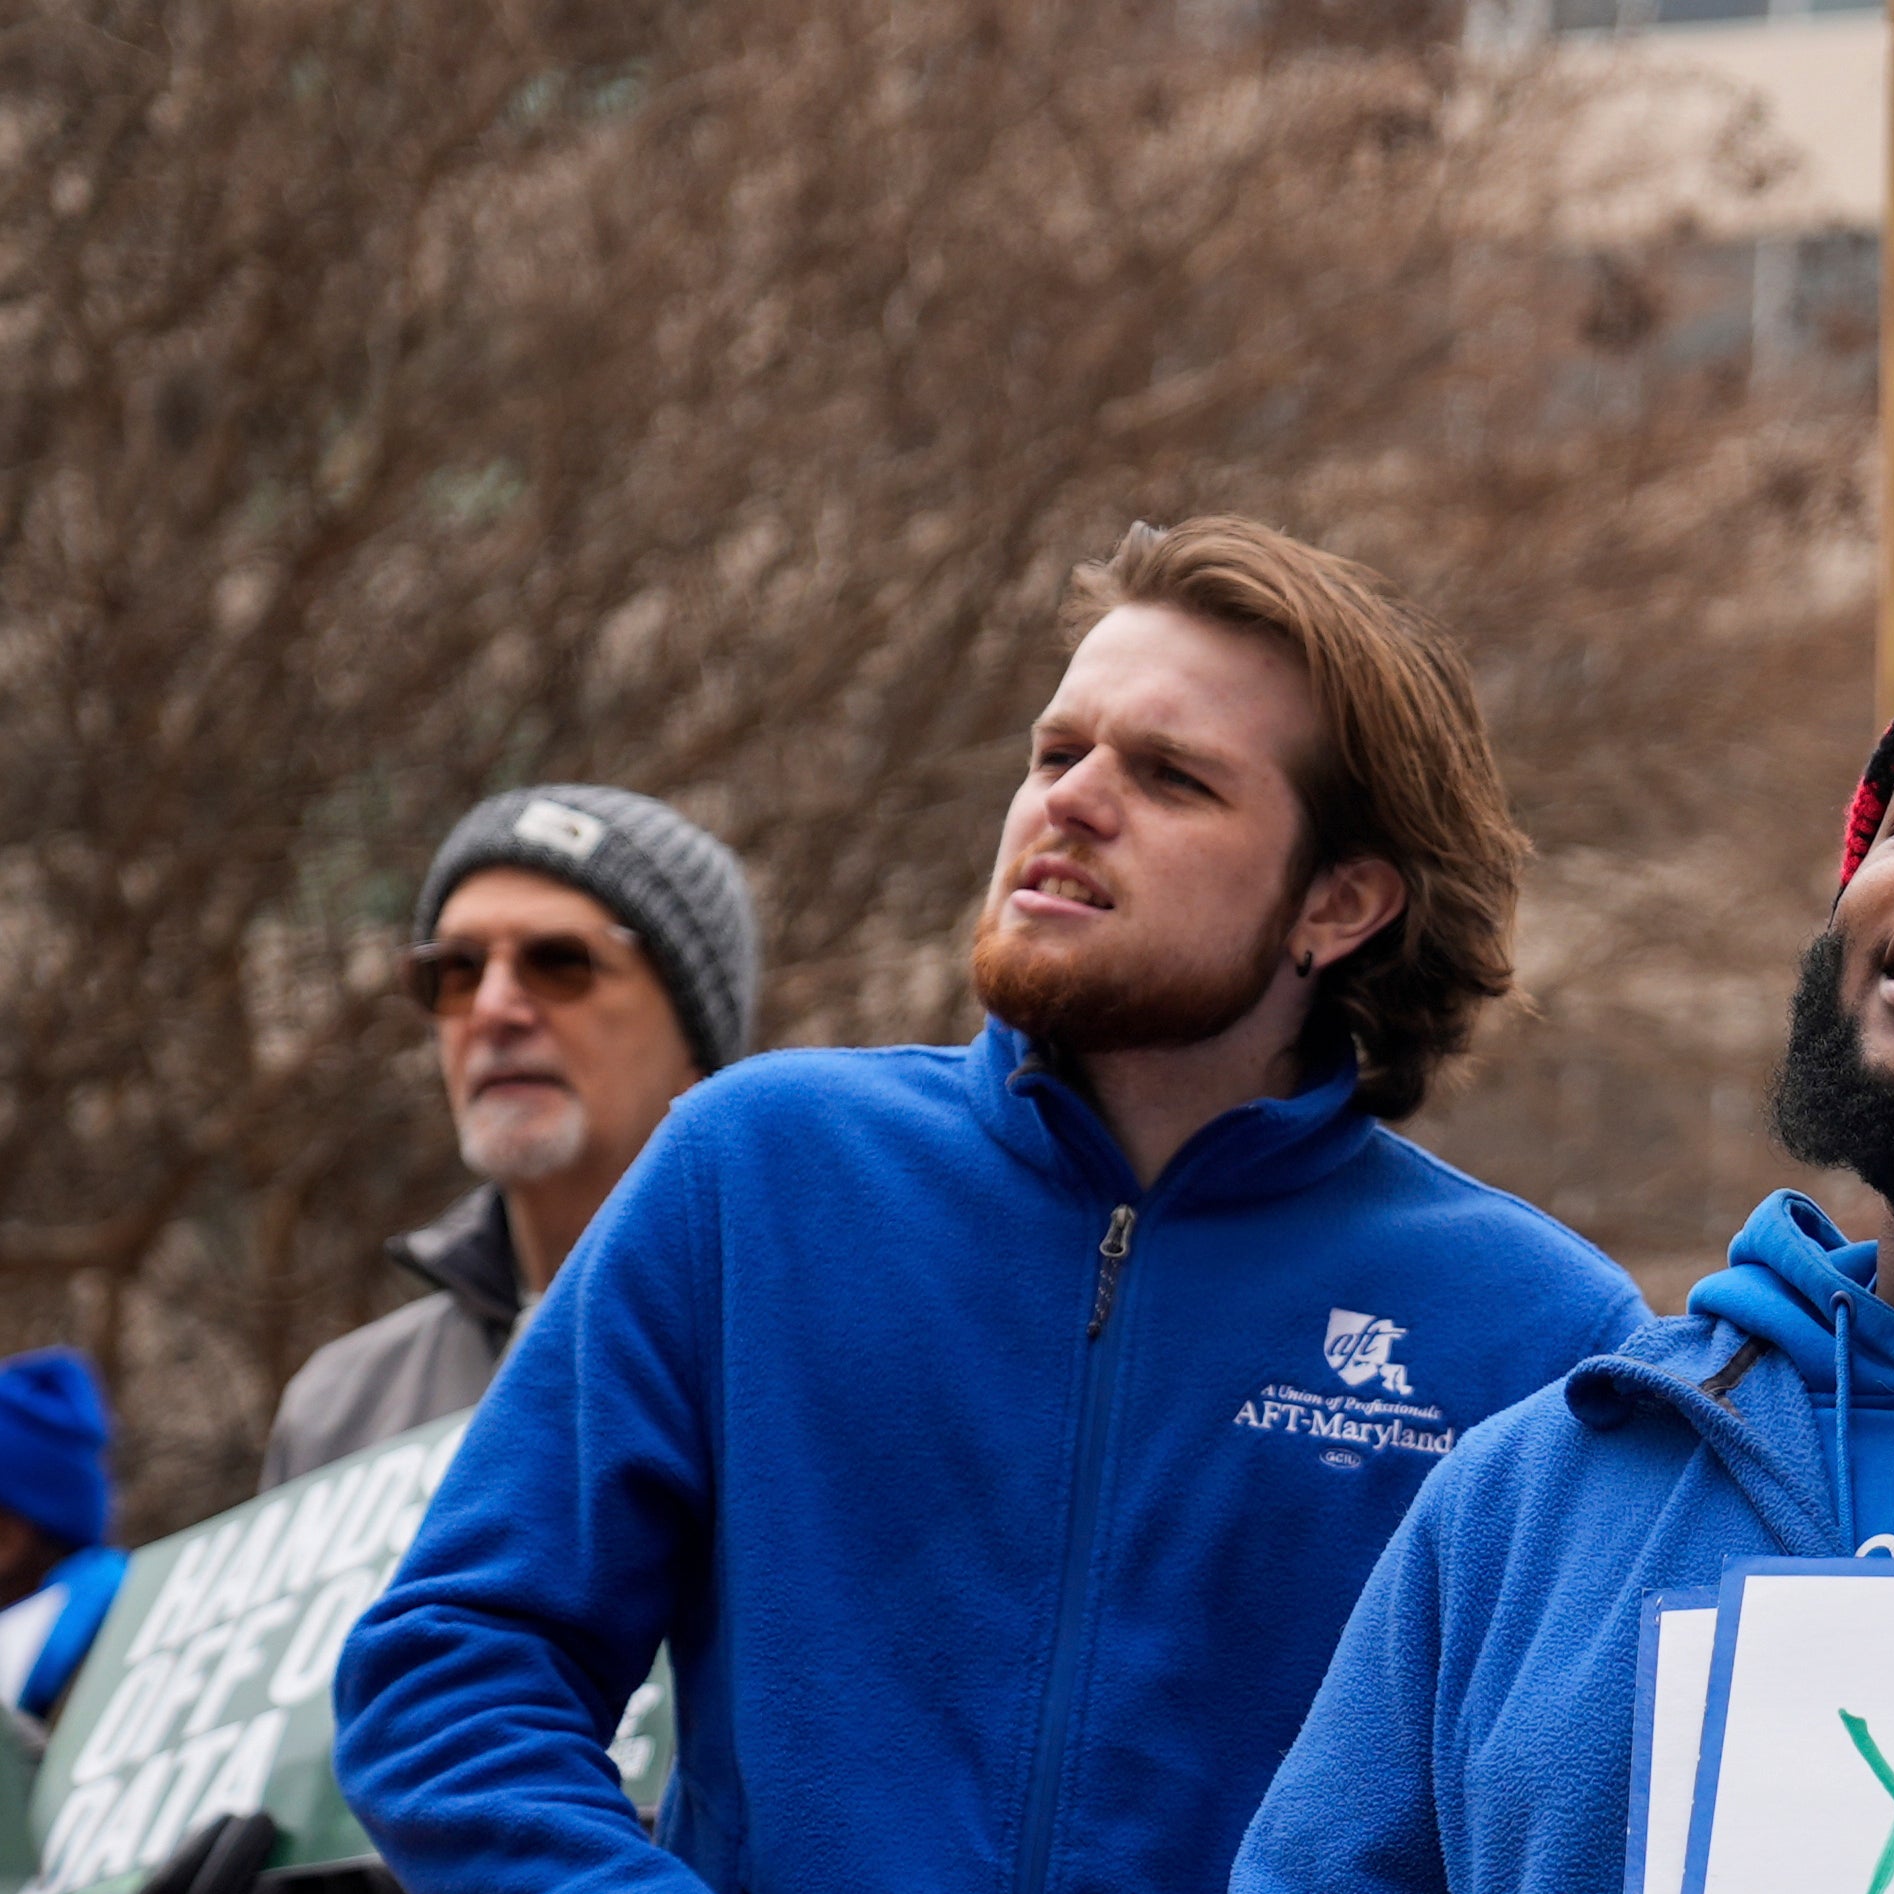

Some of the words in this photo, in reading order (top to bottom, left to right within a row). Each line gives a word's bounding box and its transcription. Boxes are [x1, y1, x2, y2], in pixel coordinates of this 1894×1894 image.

[1328, 1316, 1406, 1370] aft
[1233, 1400, 1456, 1455] AFT-Maryland
[1278, 1386, 1323, 1405] Union
[1325, 1397, 1343, 1413] of
[1344, 1397, 1444, 1420] Professionals
[72, 1596, 300, 1785] OFF
